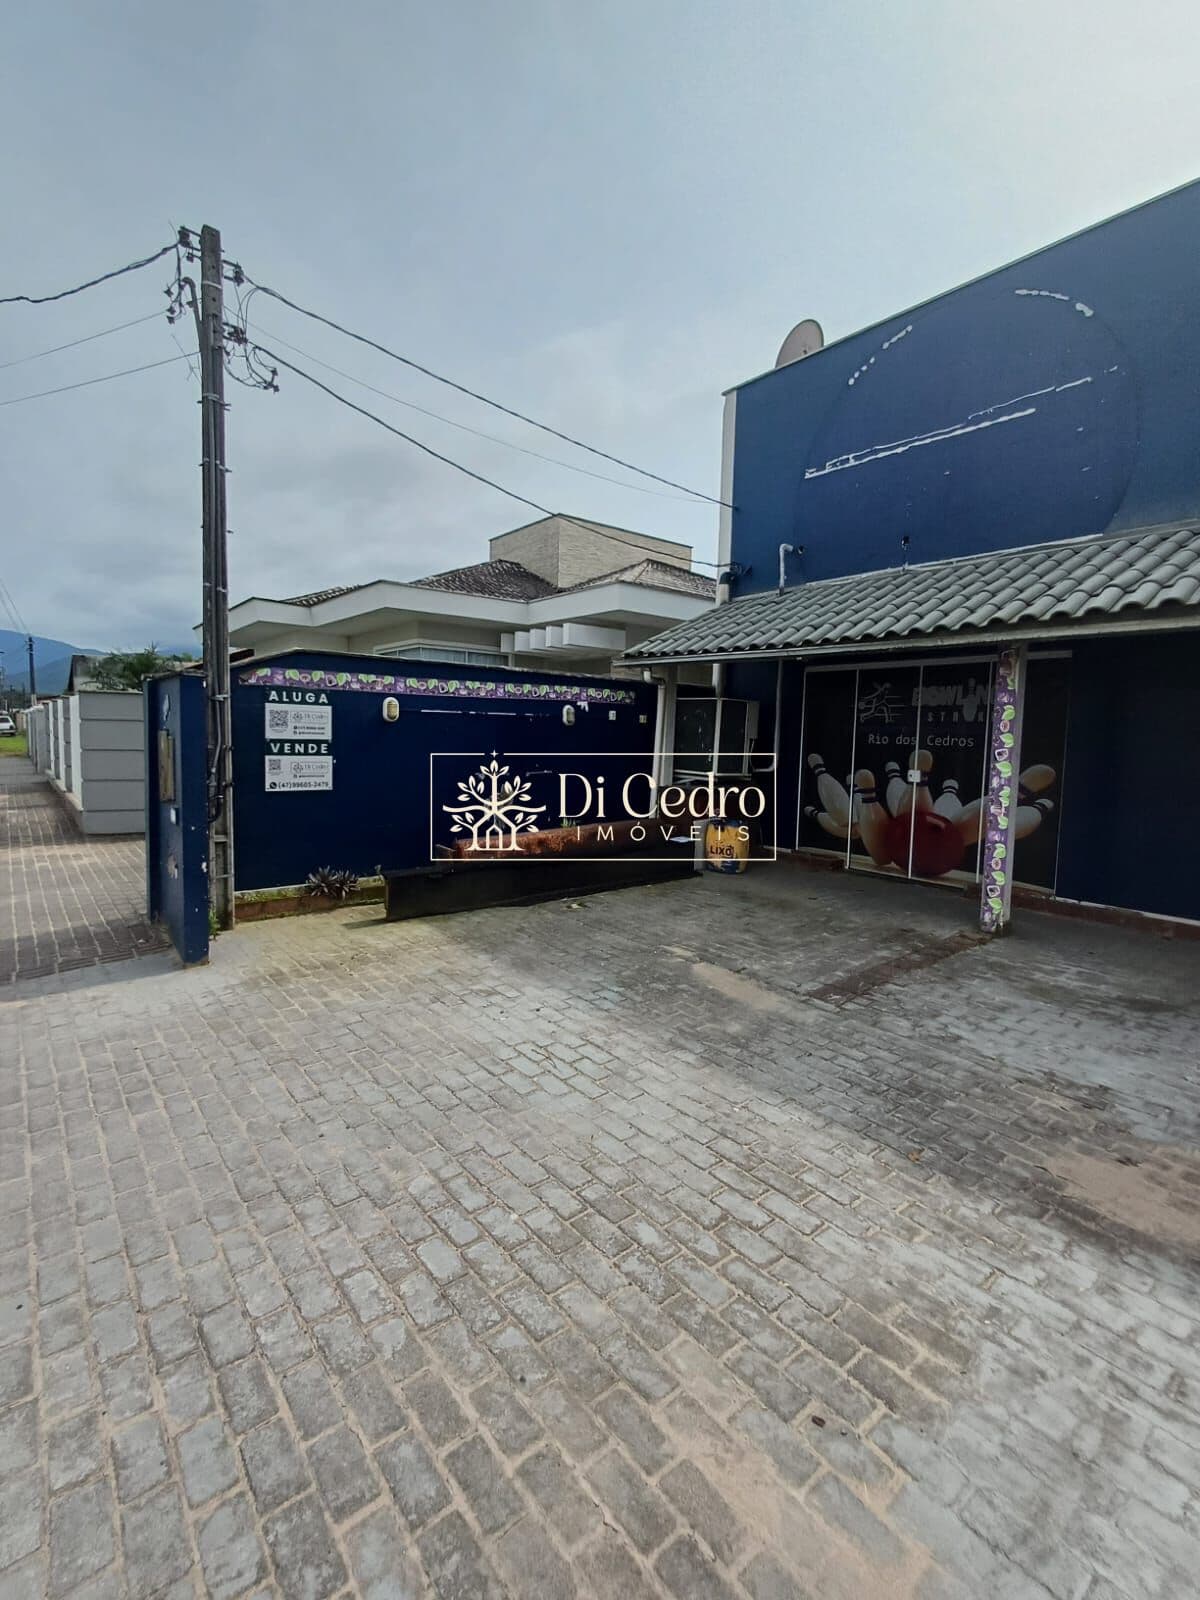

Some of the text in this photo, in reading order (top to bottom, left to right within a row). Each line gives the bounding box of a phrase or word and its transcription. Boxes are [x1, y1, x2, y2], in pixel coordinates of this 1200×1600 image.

[268, 690, 329, 704] ALUGA
[868, 733, 975, 747] Rio dos Cedros
[270, 742, 329, 754] VENDE
